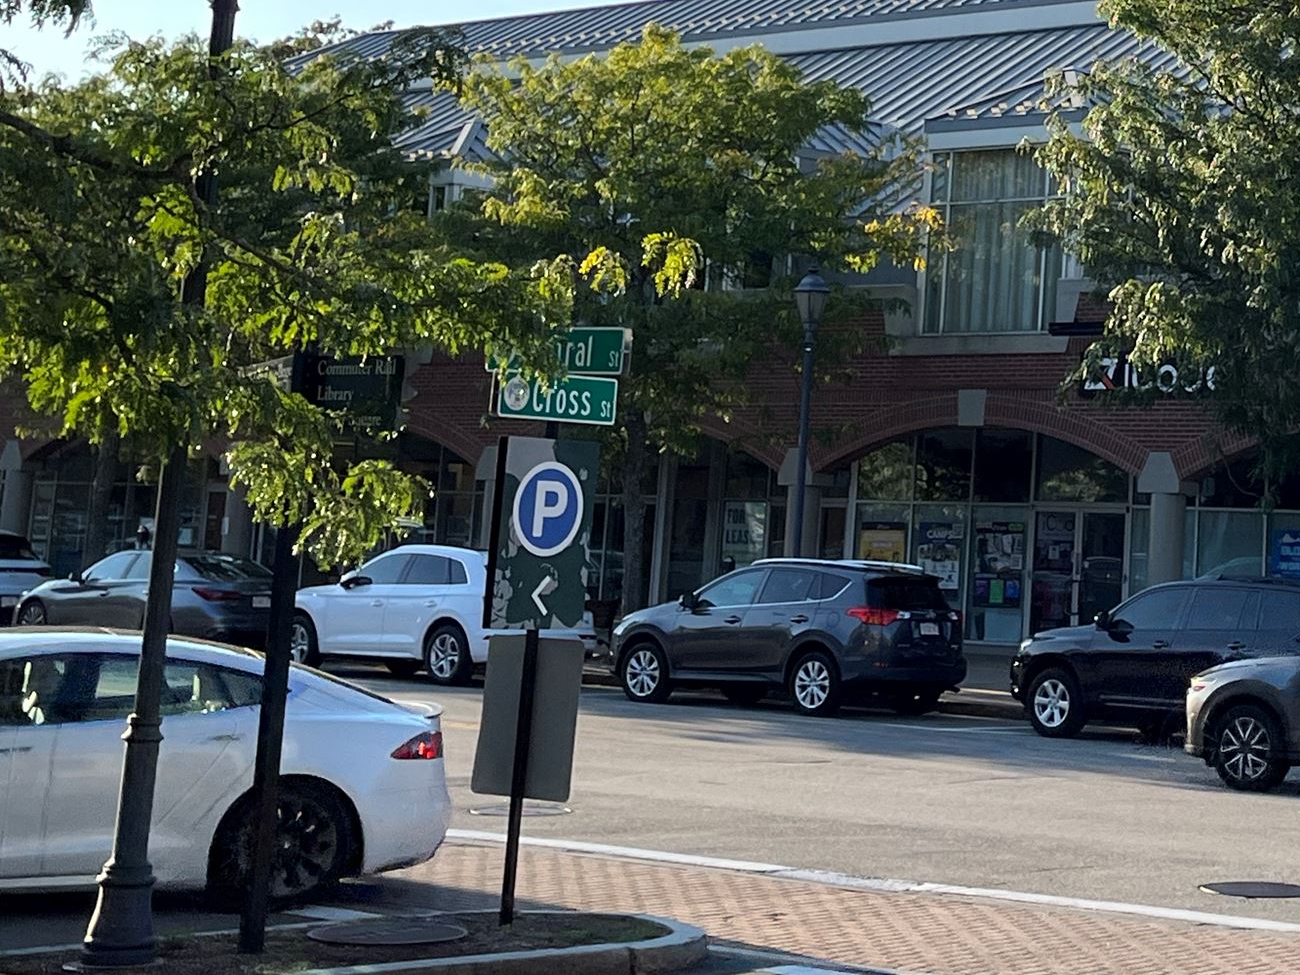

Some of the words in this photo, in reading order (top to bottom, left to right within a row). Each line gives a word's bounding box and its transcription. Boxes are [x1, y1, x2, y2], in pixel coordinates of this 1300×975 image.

[317, 360, 373, 375] Commuter
[375, 360, 397, 375] Rail
[317, 385, 353, 402] Library
[533, 378, 591, 416] Cross
[601, 400, 611, 418] St
[532, 480, 569, 538] P
[727, 508, 746, 524] FOR
[726, 529, 751, 544] LEAS
